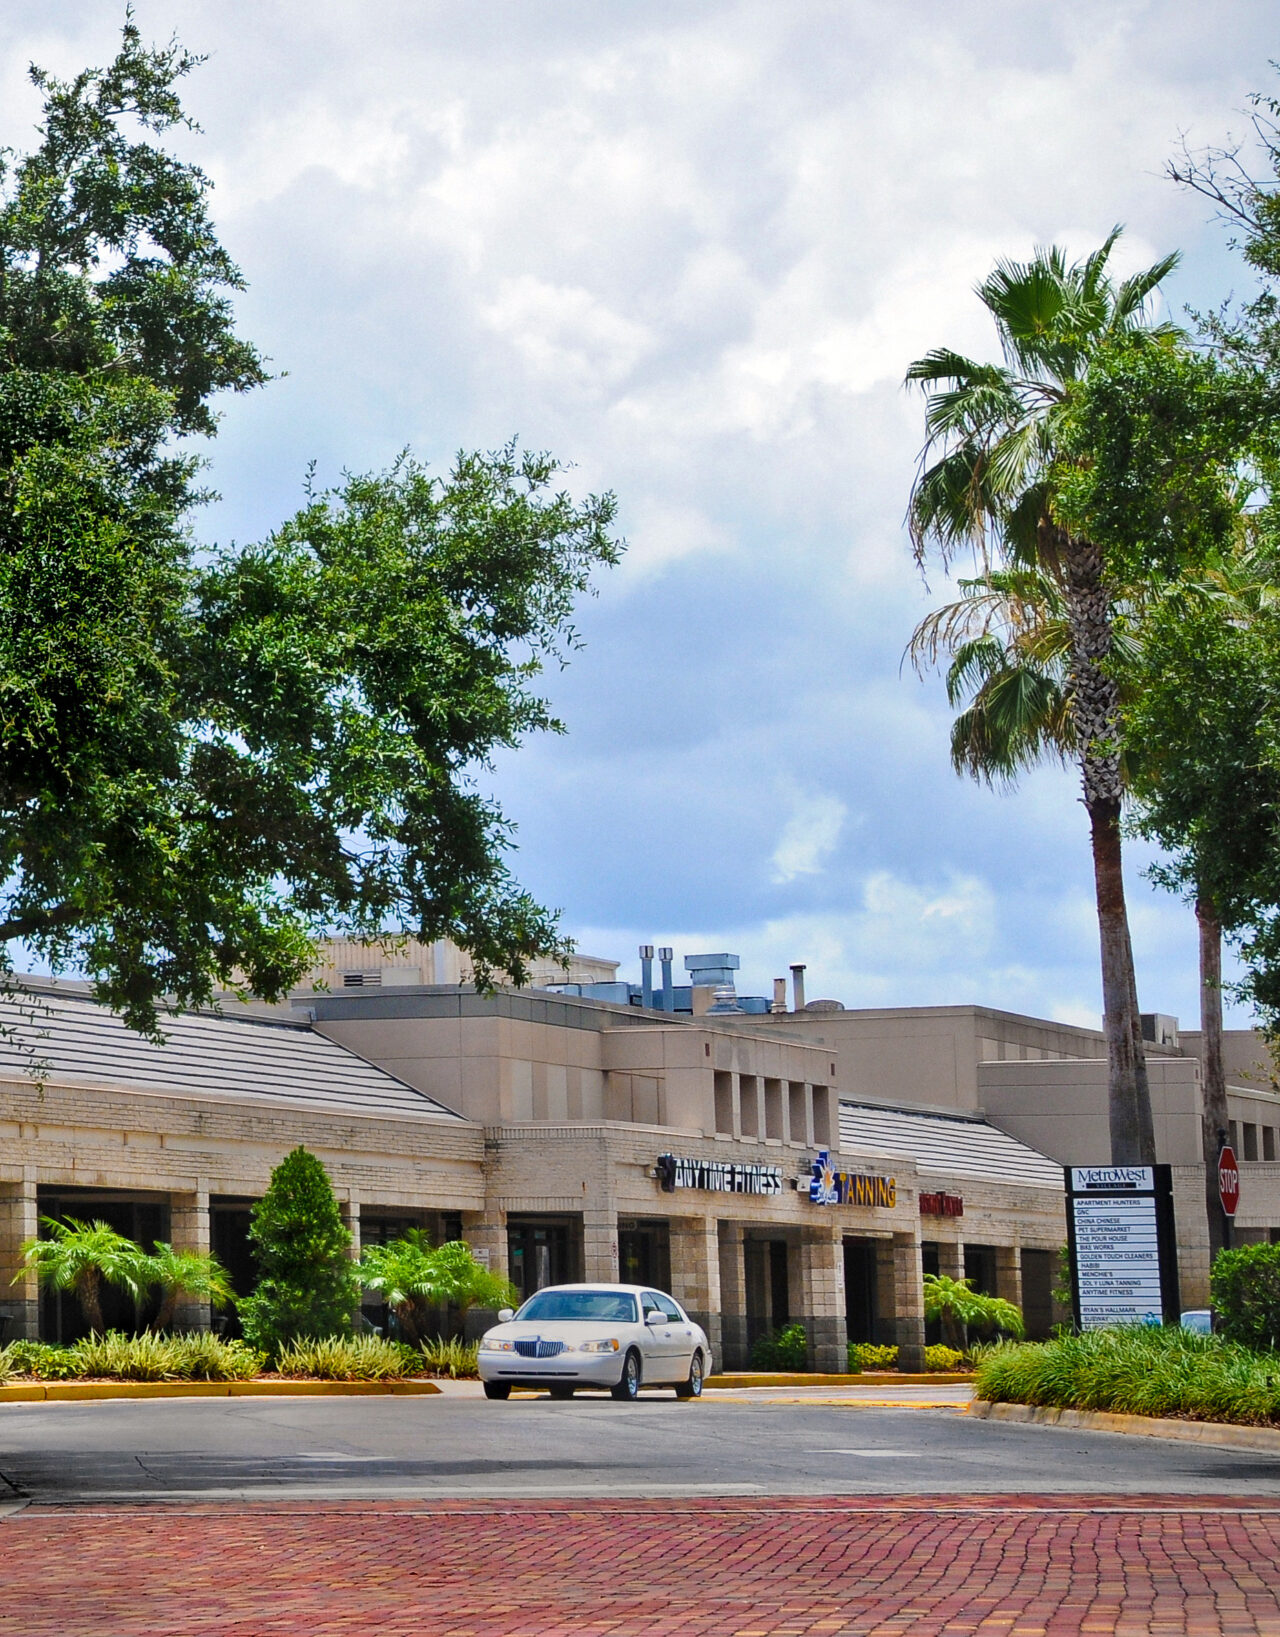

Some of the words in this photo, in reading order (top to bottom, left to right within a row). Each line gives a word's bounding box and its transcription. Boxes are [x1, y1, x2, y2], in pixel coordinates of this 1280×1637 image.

[674, 1158, 731, 1191] ANYTIME
[734, 1164, 782, 1195] FITNESS
[840, 1171, 896, 1208] TANNING
[1078, 1168, 1147, 1182] MetroWest
[1220, 1168, 1238, 1194] STOP
